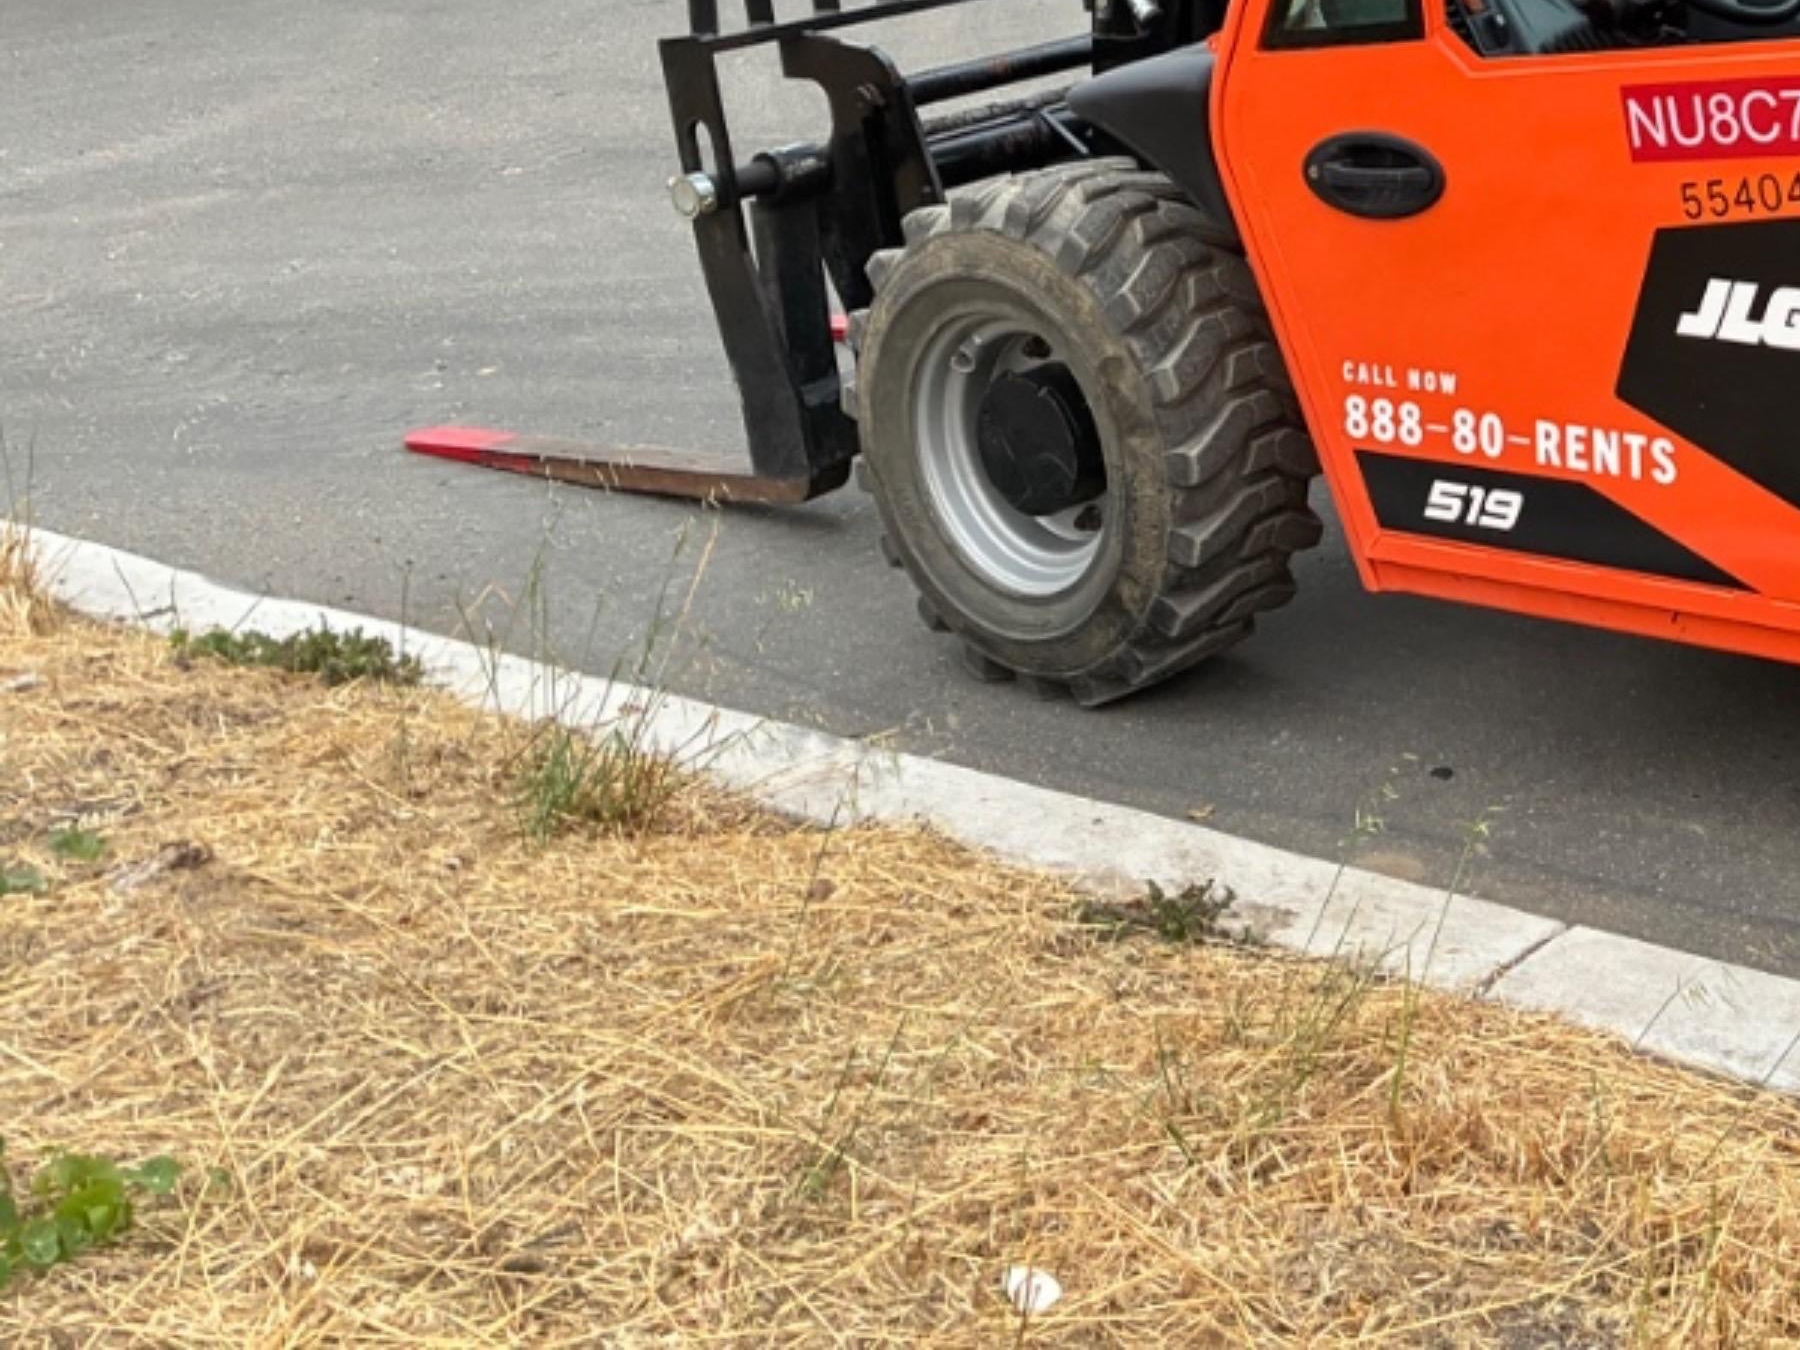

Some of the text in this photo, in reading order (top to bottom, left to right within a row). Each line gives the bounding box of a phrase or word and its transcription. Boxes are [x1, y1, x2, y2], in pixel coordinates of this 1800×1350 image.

[1342, 361, 1458, 395] CALL NOW
[1343, 394, 1678, 485] 888-80-RENTS
[1423, 479, 1525, 531] 519
